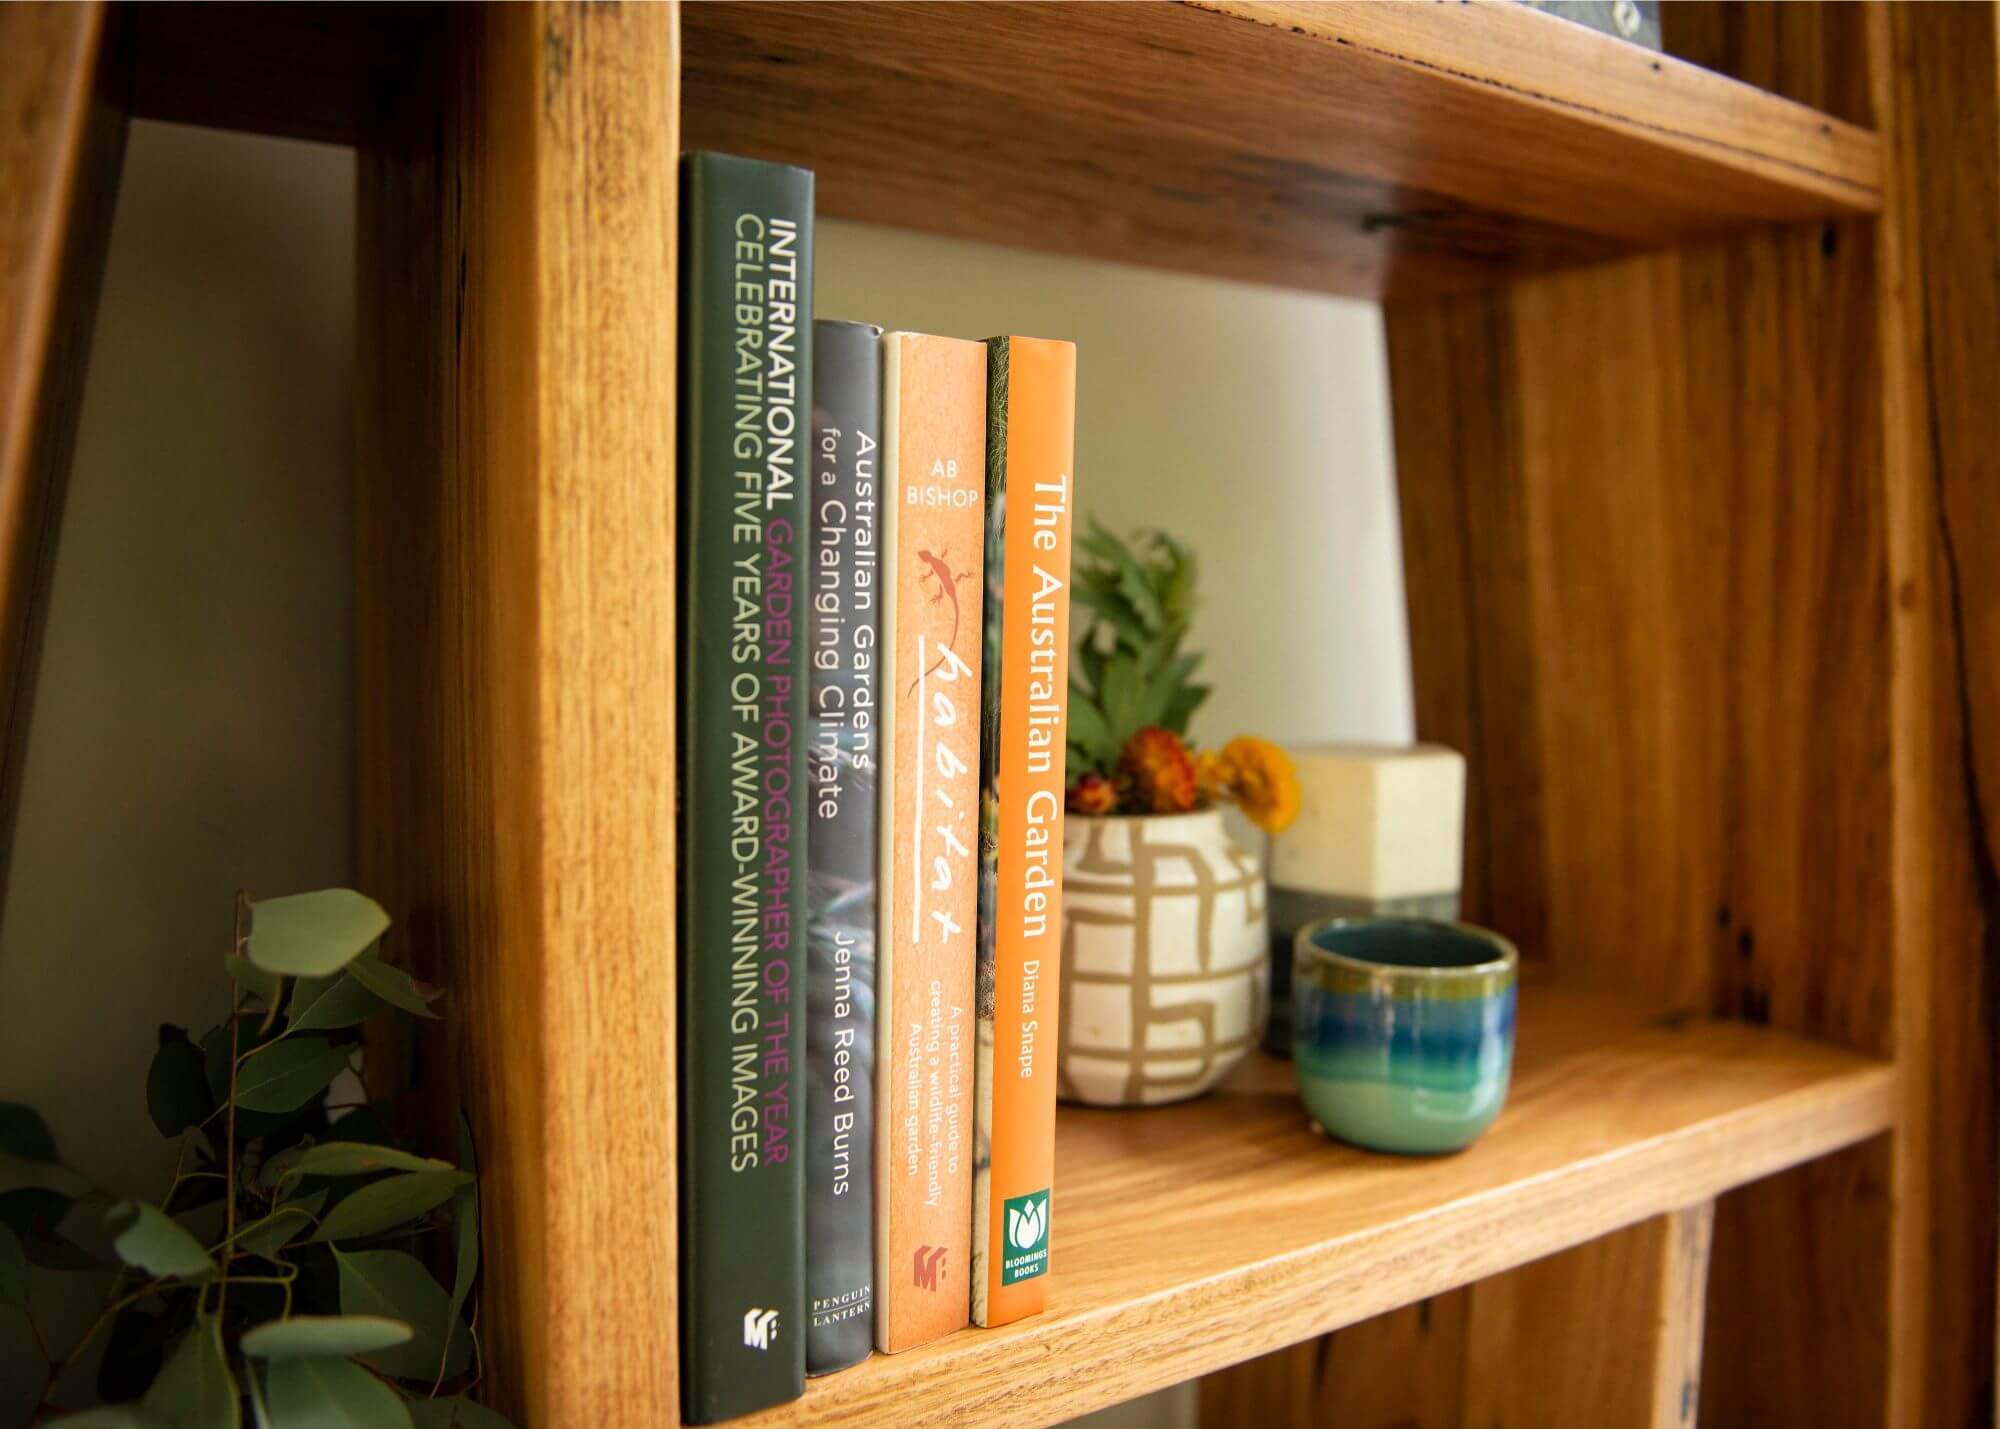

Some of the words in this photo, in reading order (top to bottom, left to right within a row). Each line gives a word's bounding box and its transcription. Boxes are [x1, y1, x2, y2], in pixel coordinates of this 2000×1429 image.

[734, 213, 765, 459] CELEBRATING
[766, 218, 797, 511] INTERNATIONAL
[821, 427, 841, 463] for
[821, 472, 837, 486] a
[931, 459, 957, 479] AB
[733, 472, 761, 544] FIVE
[854, 430, 877, 610] Australian
[907, 485, 978, 508] BISHOP
[1033, 474, 1067, 550] The
[732, 553, 761, 663] YEARS
[764, 518, 793, 664] GARDEN
[814, 500, 847, 670] Changing
[731, 672, 760, 722] OF
[852, 625, 875, 769] Gardens
[1028, 564, 1064, 773] Australian
[818, 685, 845, 819] Climate
[763, 675, 791, 950] PHOTOGRAPHER
[931, 642, 973, 944] habitat
[731, 732, 759, 1034] AWARD-WINNING
[1023, 790, 1058, 937] Garden
[763, 959, 789, 1003] OF
[834, 931, 855, 1018] Jenna
[1022, 960, 1040, 1014] Diana
[764, 1012, 788, 1077] THE
[927, 980, 942, 1053] creating
[950, 1006, 962, 1018] A
[1018, 1020, 1038, 1078] Snape
[834, 1028, 855, 1102] Reed
[907, 1023, 922, 1110] Australian
[928, 1056, 940, 1066] a
[947, 1024, 962, 1099] practical
[731, 1044, 758, 1173] IMAGES
[763, 1081, 788, 1165] YEAR
[905, 1115, 922, 1176] garden
[924, 1071, 942, 1207] wildlife-friendly
[945, 1103, 960, 1151] guide
[833, 1111, 854, 1195] Burns
[948, 1155, 960, 1175] to
[1005, 1249, 1047, 1269] BLOOMINGS
[1014, 1263, 1039, 1278] BOOKS
[813, 1302, 871, 1327] LANTERN
[814, 1285, 871, 1311] PENGUIN
